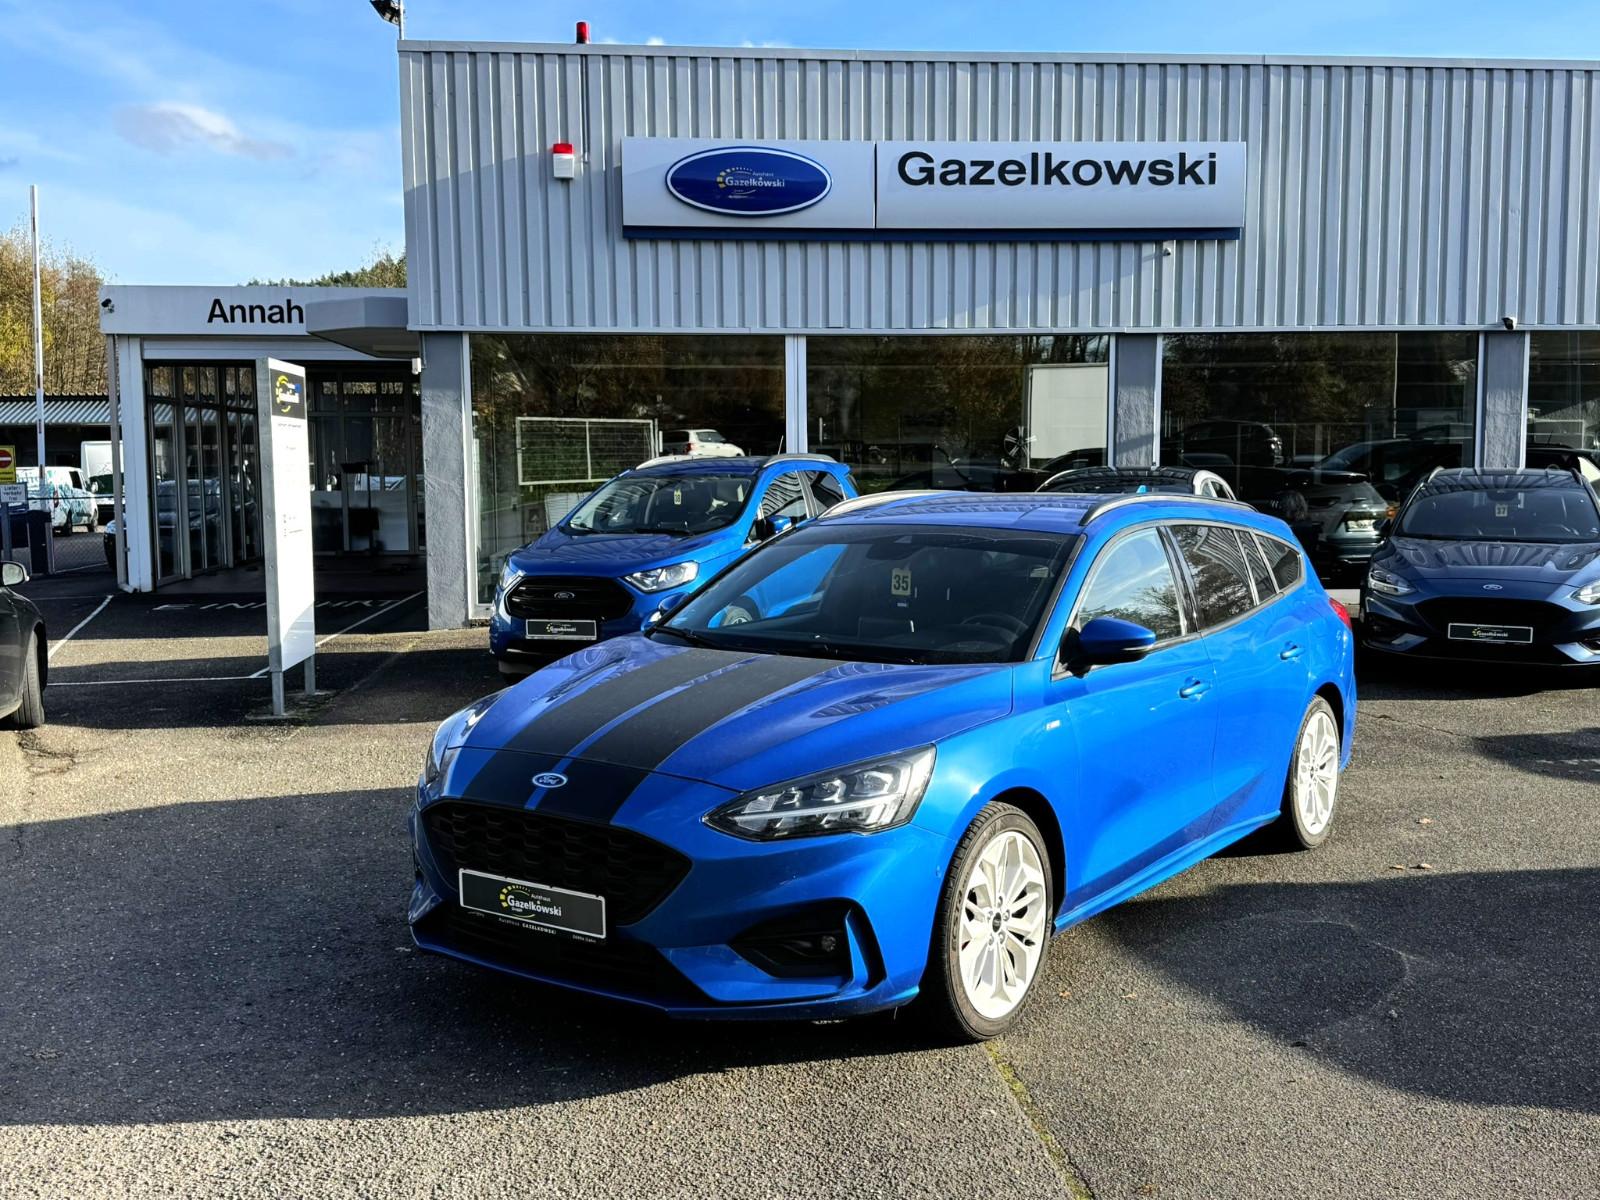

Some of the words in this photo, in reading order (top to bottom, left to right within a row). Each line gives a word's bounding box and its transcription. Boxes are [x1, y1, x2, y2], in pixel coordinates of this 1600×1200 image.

[898, 151, 1217, 186] Gazelkowski
[725, 176, 785, 188] Gazelkowski
[207, 298, 304, 324] Annah
[893, 574, 909, 591] 35
[507, 894, 562, 917] Gazelkowski
